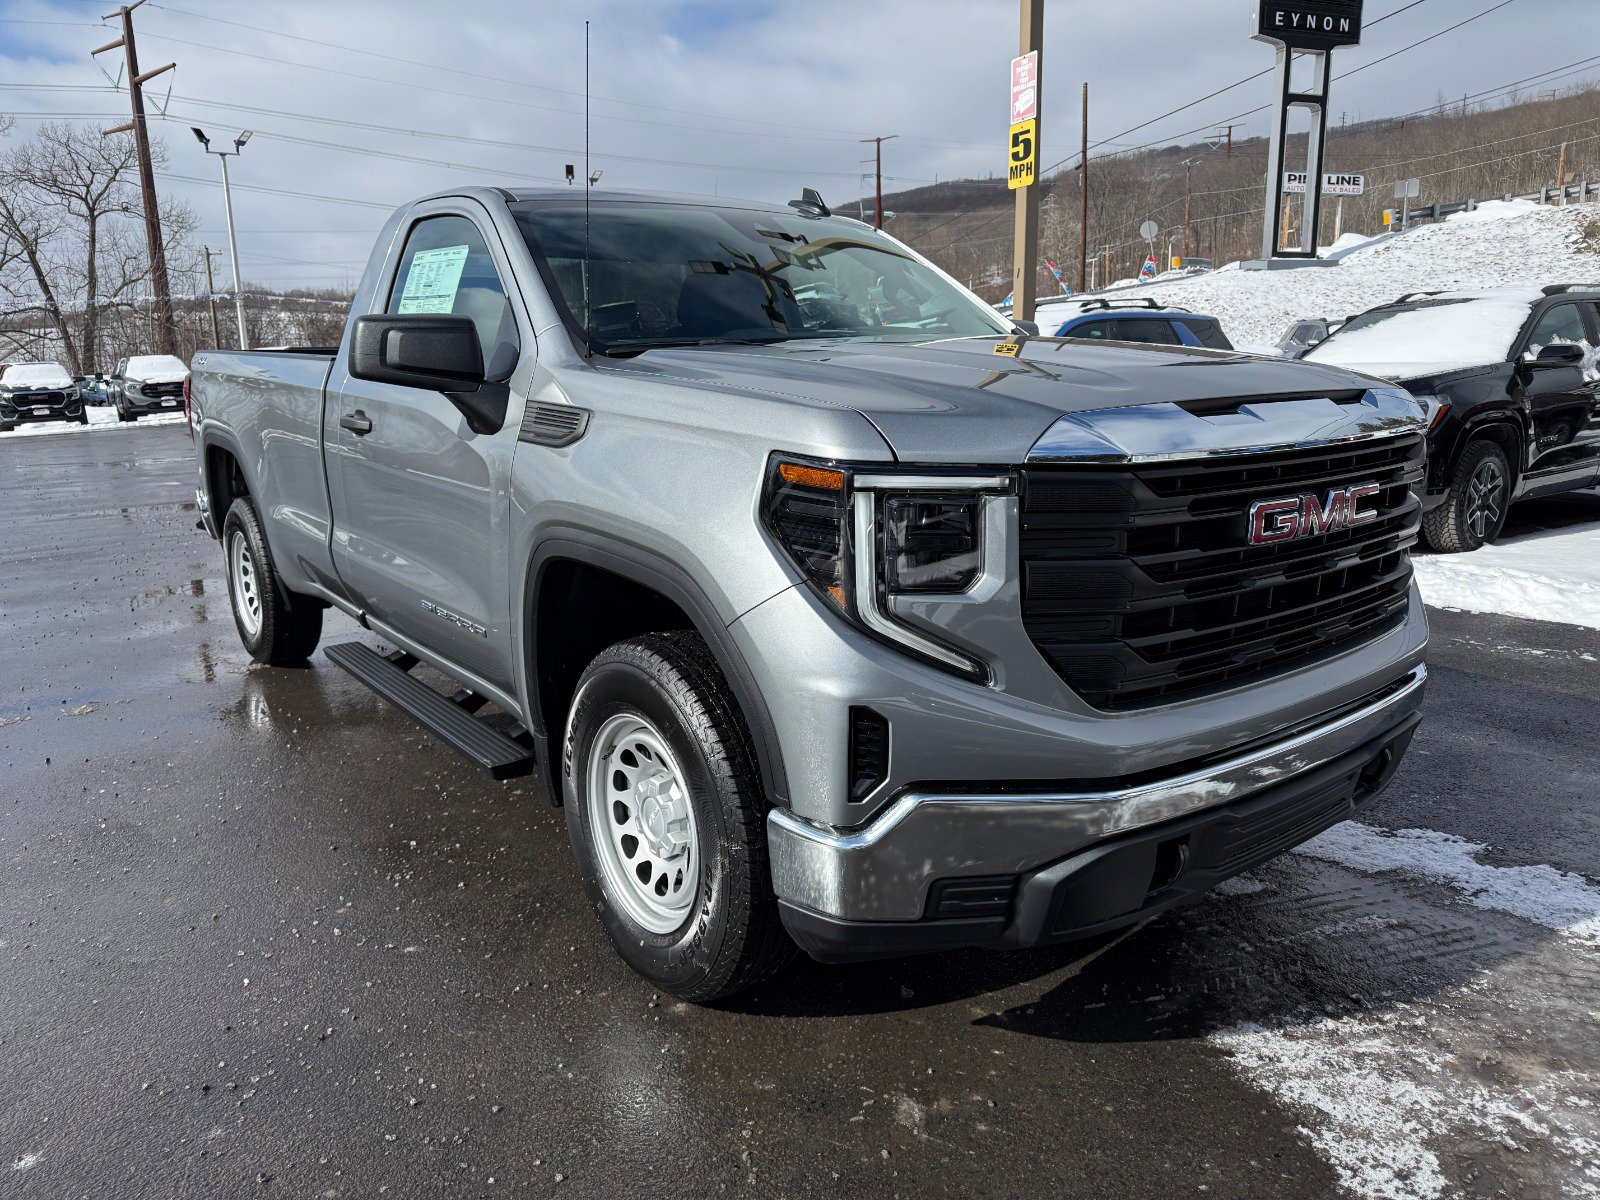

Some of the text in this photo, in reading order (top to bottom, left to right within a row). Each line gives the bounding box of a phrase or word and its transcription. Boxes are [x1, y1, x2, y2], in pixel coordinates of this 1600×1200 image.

[1275, 11, 1349, 32] EYNON
[1012, 129, 1031, 162] 5
[1010, 161, 1033, 180] MPH
[1287, 173, 1361, 186] PI LINE
[1248, 482, 1380, 546] GMC
[421, 599, 487, 638] SIERRA
